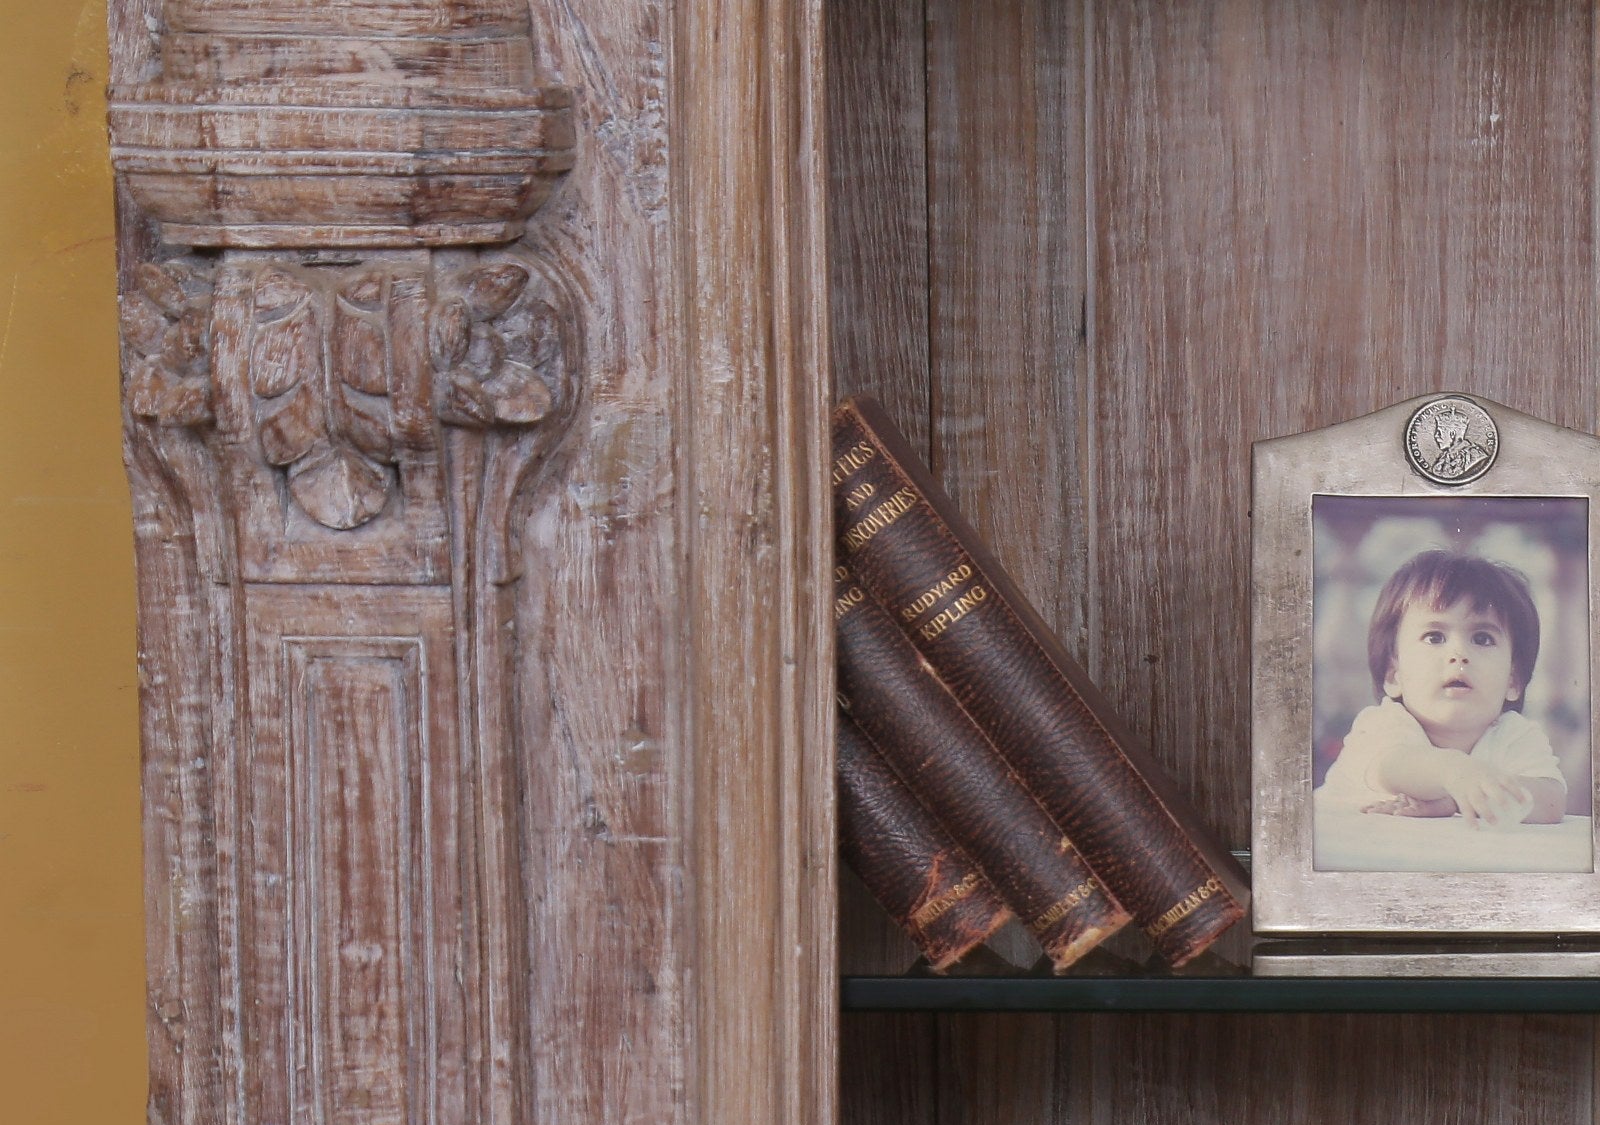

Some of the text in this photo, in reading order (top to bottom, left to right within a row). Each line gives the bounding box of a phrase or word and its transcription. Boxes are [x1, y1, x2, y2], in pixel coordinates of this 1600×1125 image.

[841, 485, 918, 549] DISCOVERIES
[845, 482, 875, 511] AND
[901, 563, 972, 622] RUDYARD
[919, 584, 987, 641] KIPLING
